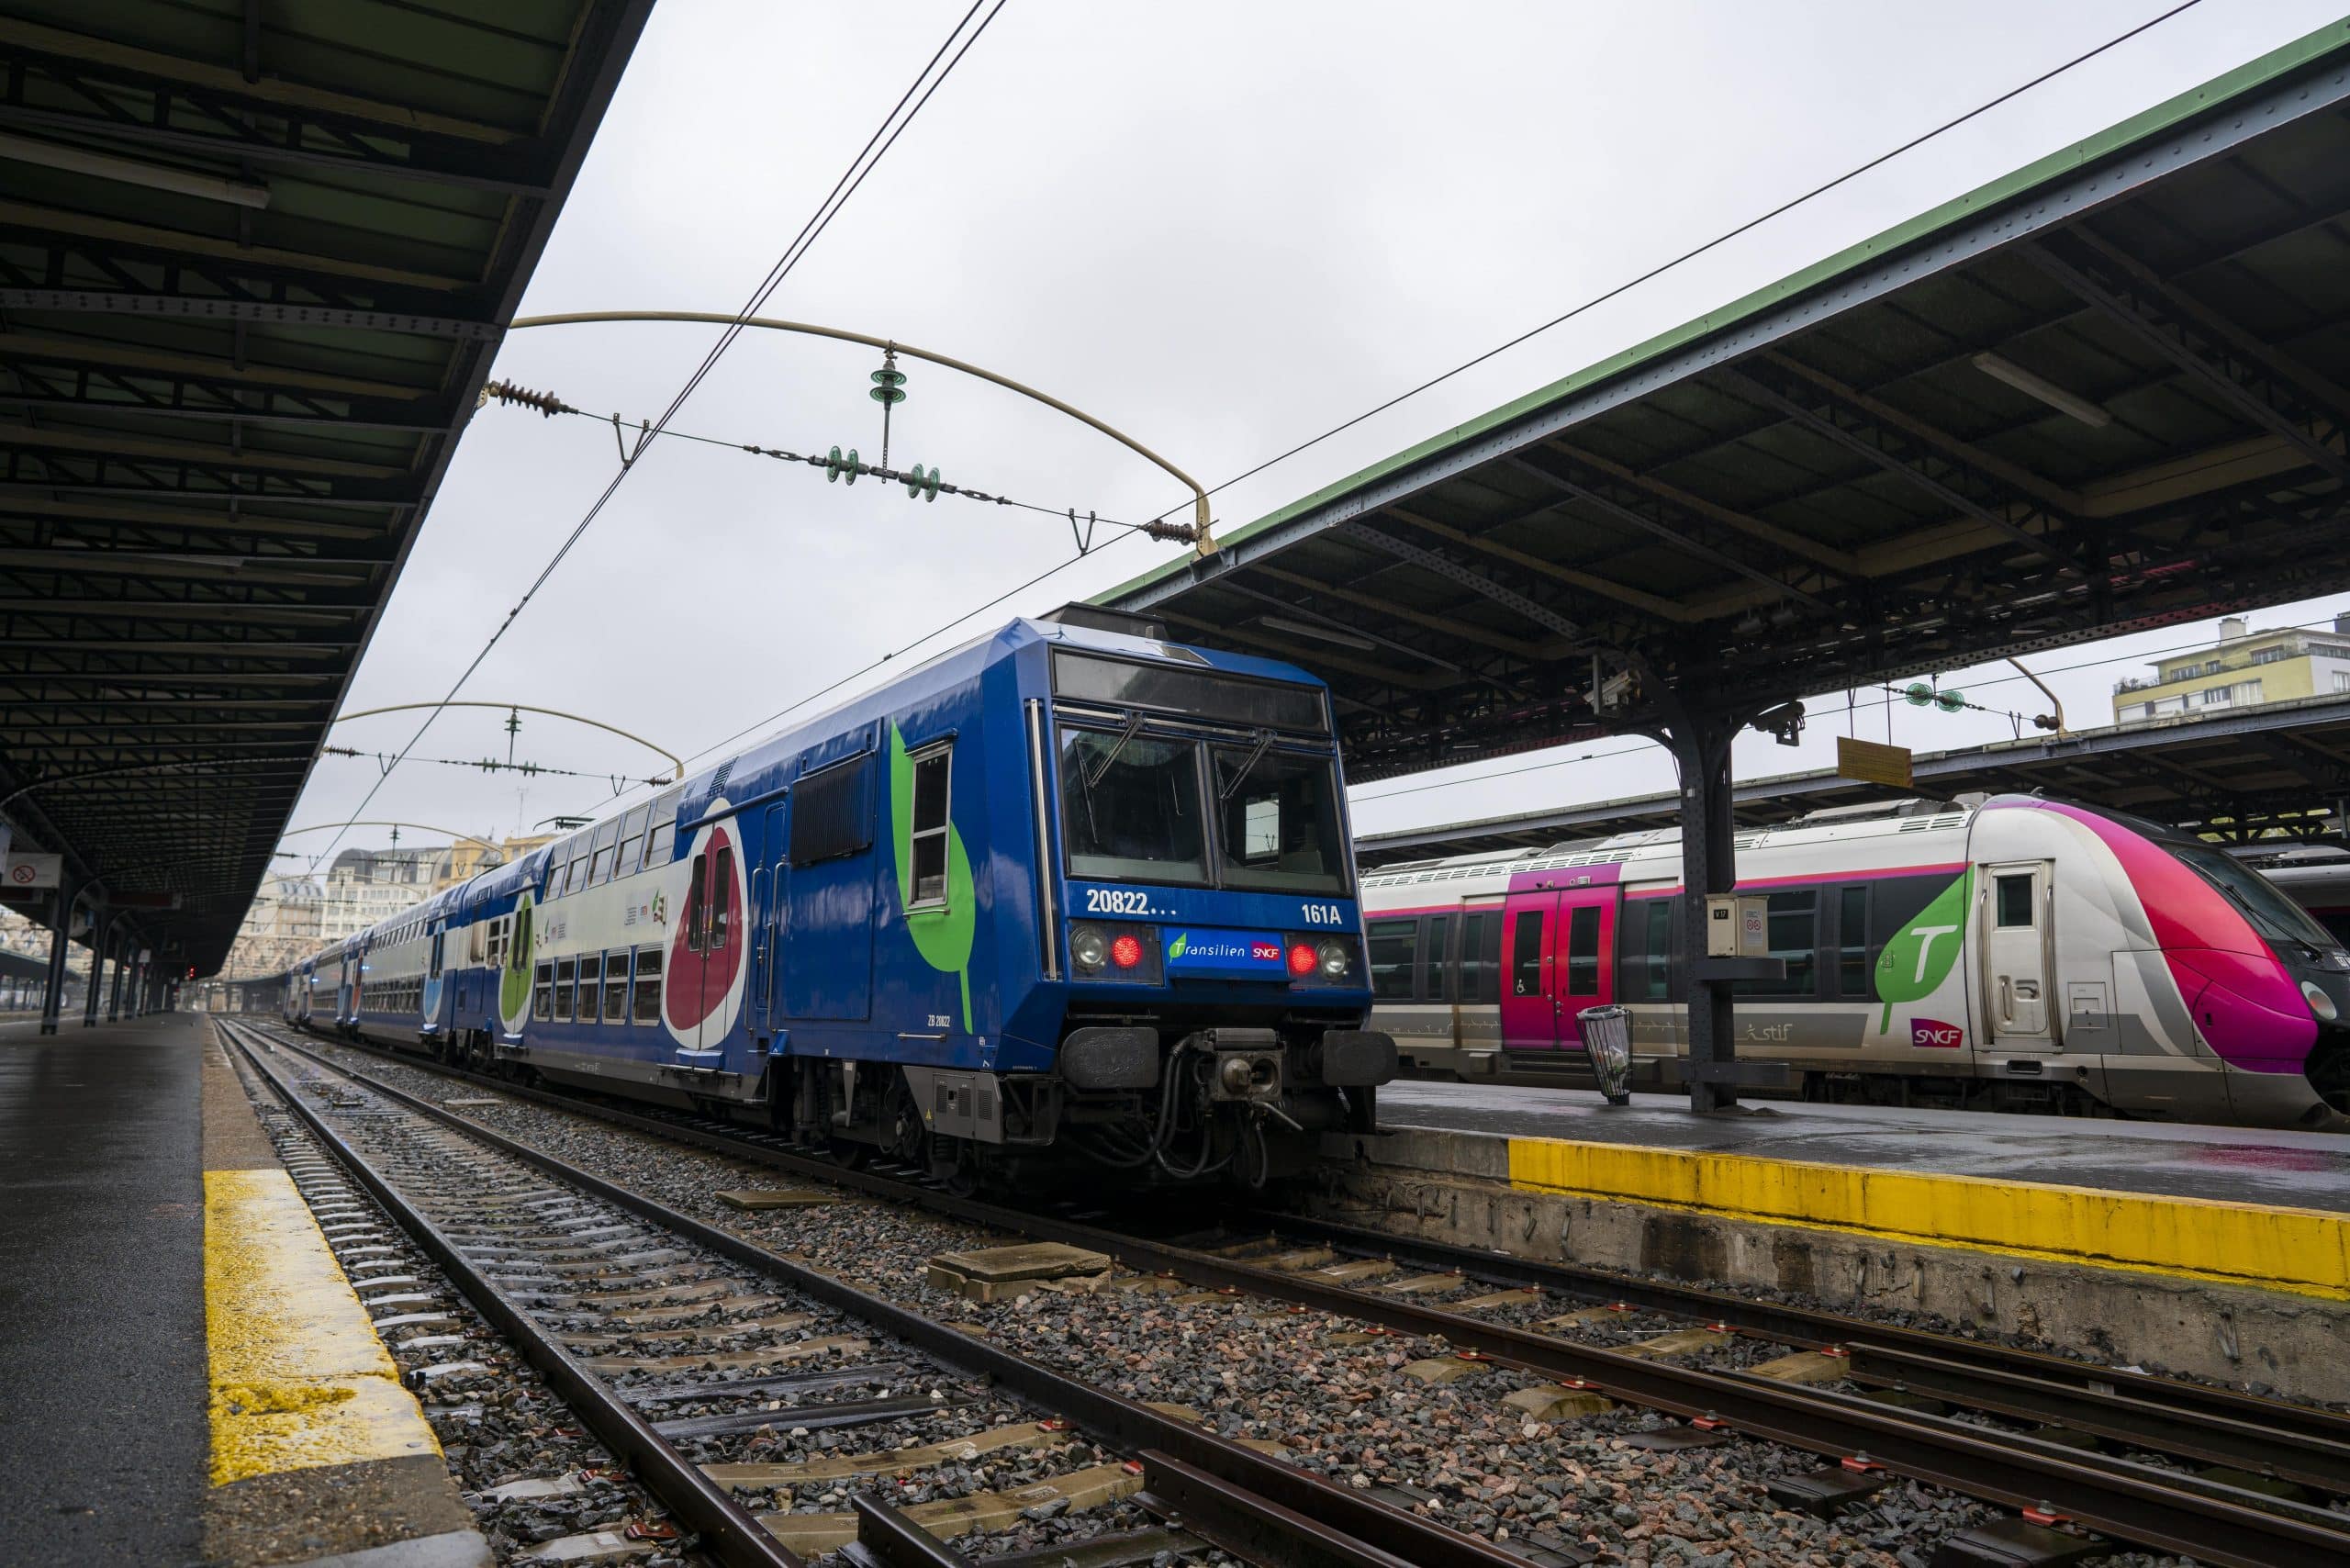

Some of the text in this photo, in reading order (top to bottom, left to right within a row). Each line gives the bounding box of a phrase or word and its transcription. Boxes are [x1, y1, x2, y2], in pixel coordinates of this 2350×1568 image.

[1302, 903, 1343, 925] 161A
[1175, 940, 1279, 960] Transilien SNCF
[1909, 924, 1958, 984] T
[1762, 1024, 1793, 1041] stif
[1914, 1029, 1960, 1045] SNCF
